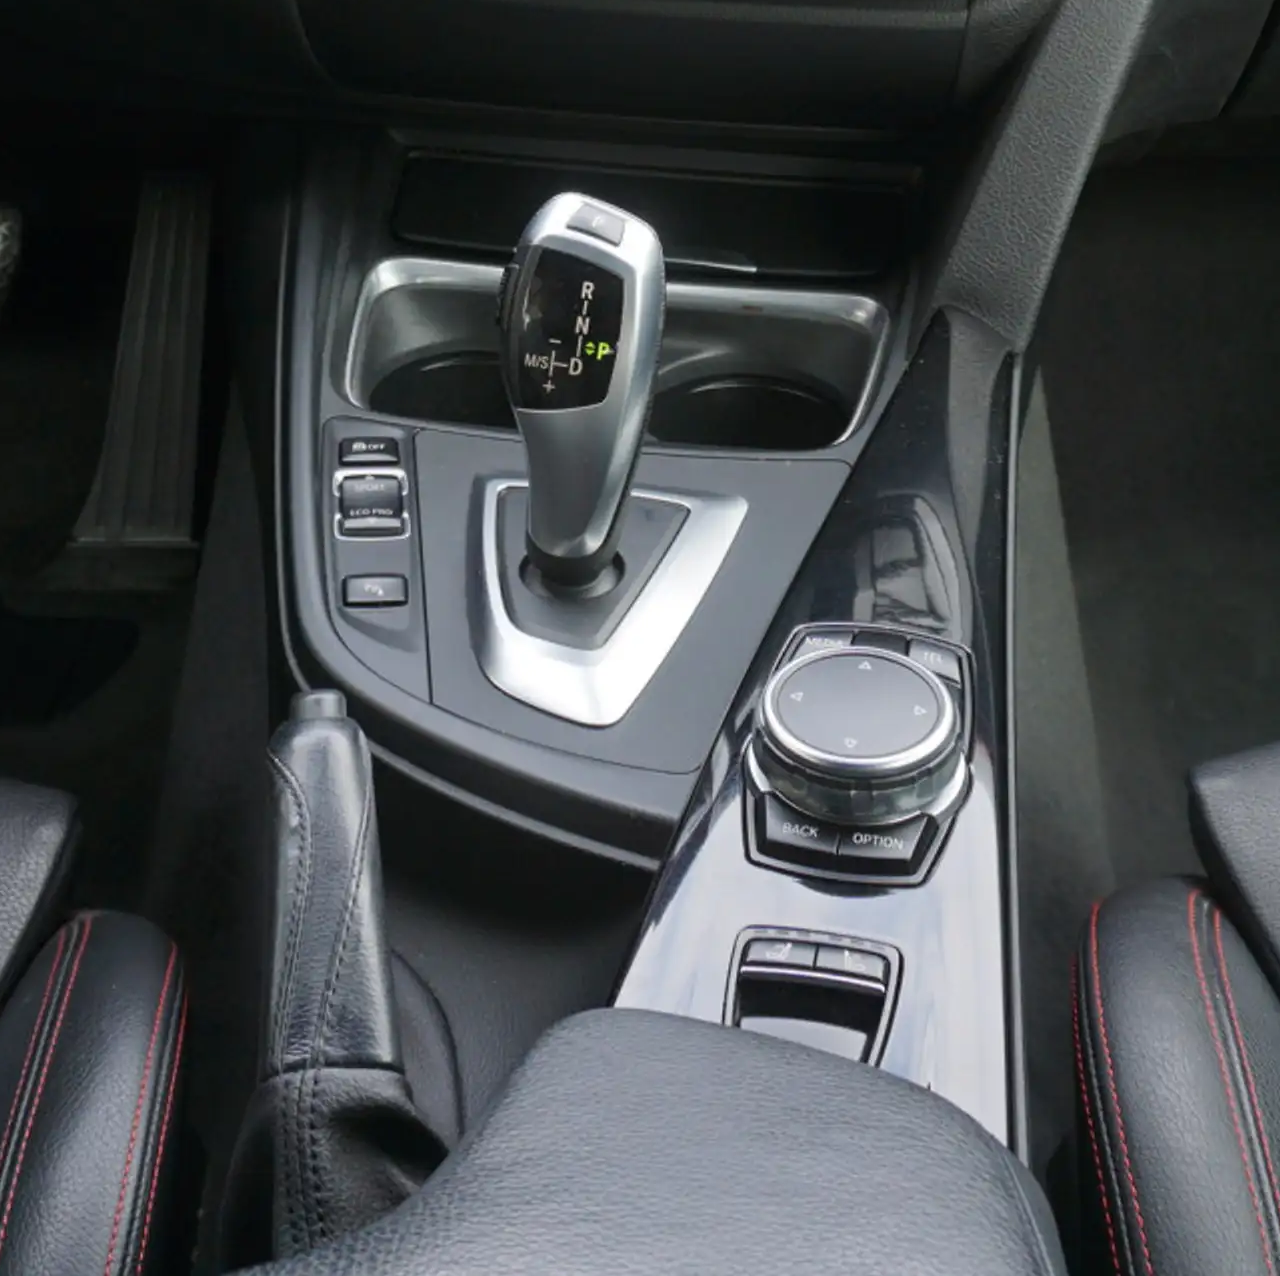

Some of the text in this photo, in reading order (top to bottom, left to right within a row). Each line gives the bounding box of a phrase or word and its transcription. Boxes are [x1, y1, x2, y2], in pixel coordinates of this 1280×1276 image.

[581, 280, 596, 300] R
[575, 316, 590, 335] N
[597, 341, 610, 360] P
[524, 353, 549, 370] M/S
[568, 358, 584, 376] D
[368, 442, 387, 451] OFF
[348, 506, 394, 517] ECO PRO
[782, 822, 819, 839] BACK
[852, 832, 904, 850] OPTION
